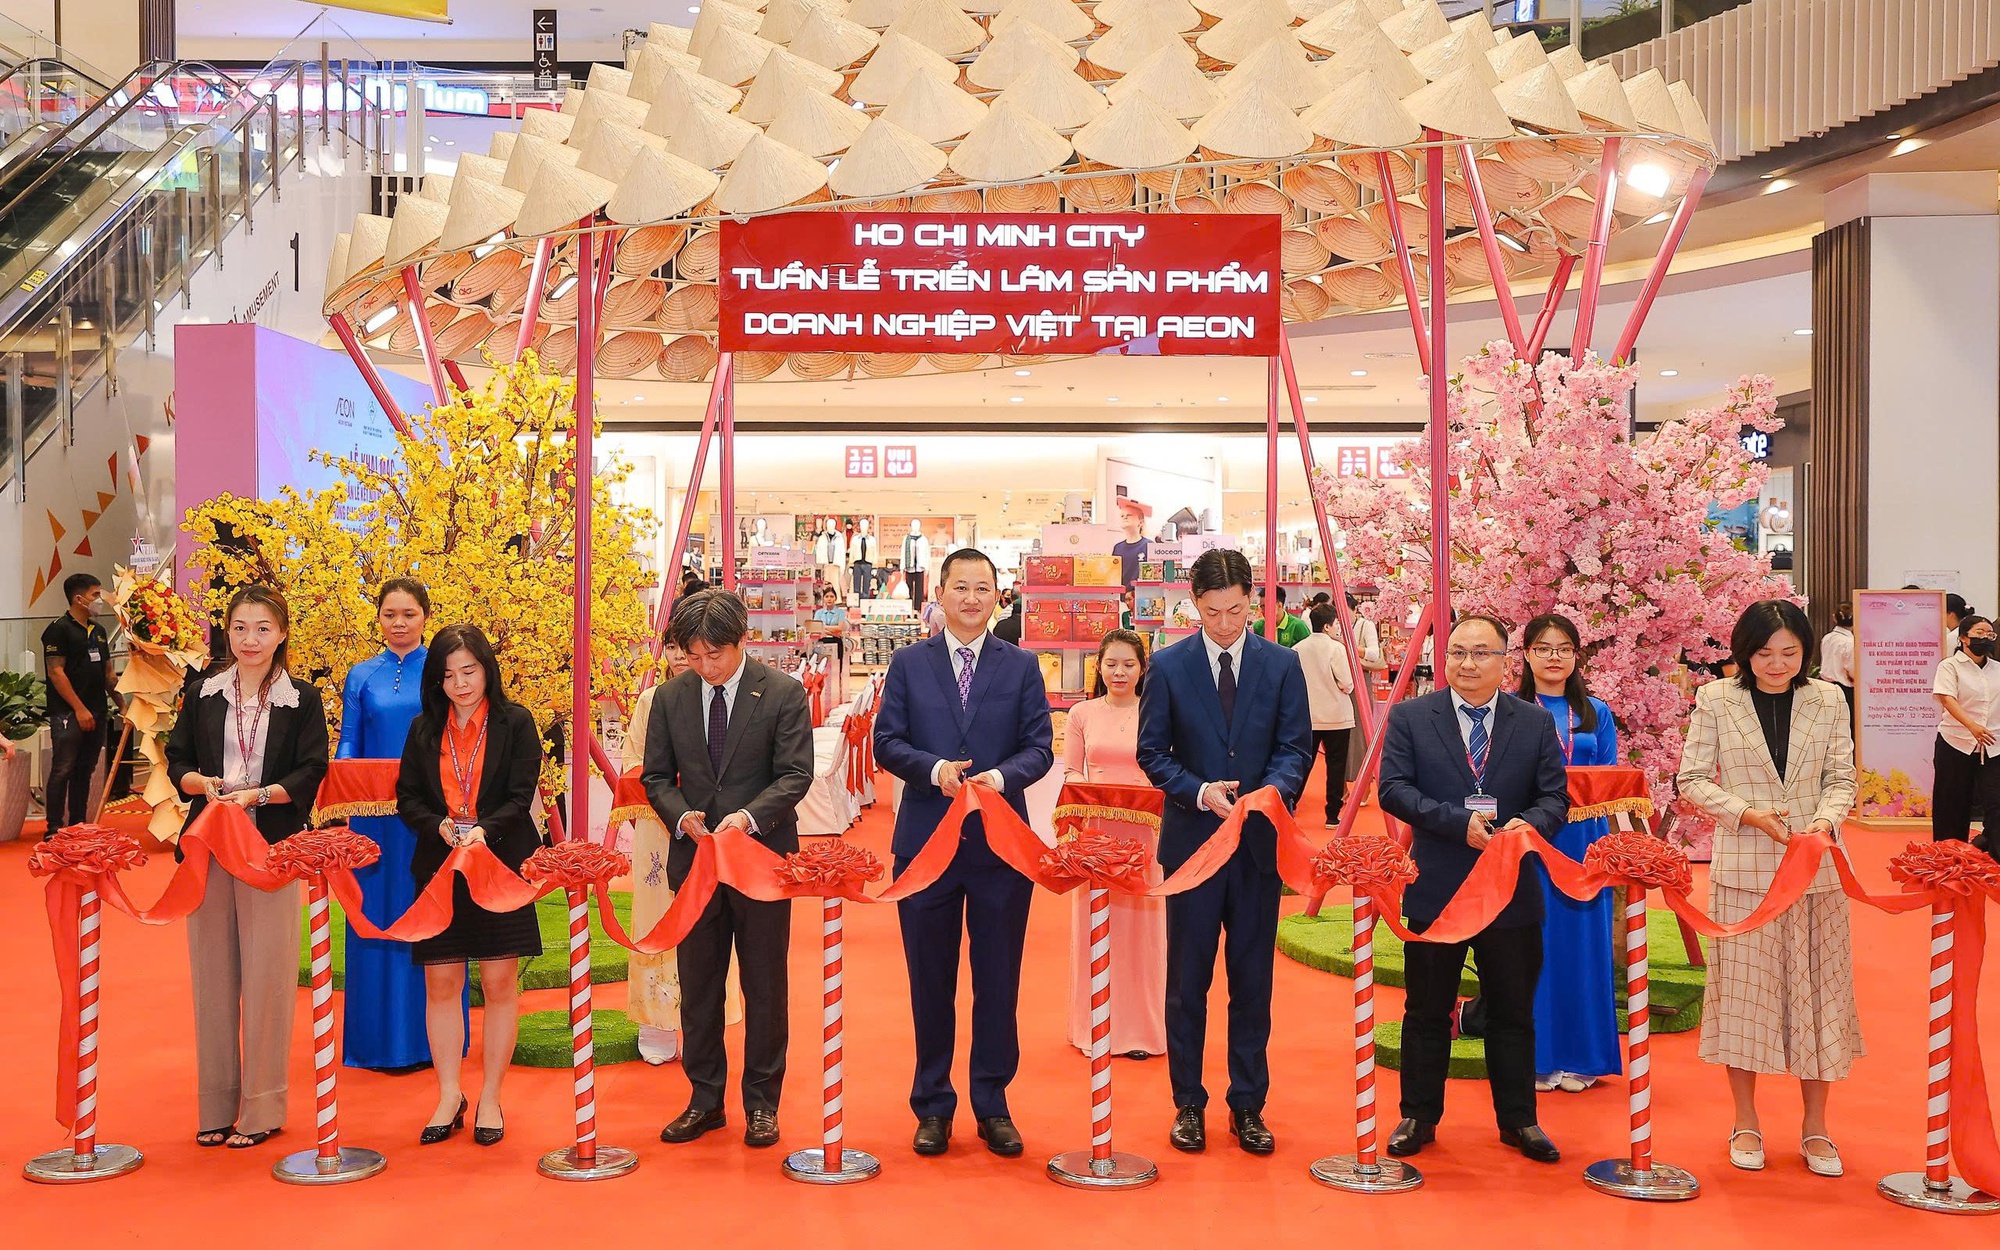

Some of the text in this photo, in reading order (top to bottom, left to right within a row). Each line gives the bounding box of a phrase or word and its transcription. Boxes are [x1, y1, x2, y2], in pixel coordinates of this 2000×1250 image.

[854, 223, 1145, 248] HO CHI MINH CITY
[731, 258, 1269, 294] TUẦN LỄ TRIỂN LÃM SẢN PHẨM
[243, 271, 280, 324] AMUSEMENT
[744, 308, 1255, 343] DOANH NGHIỆP VIỆT TẠI AEON
[1737, 431, 1767, 458] ate
